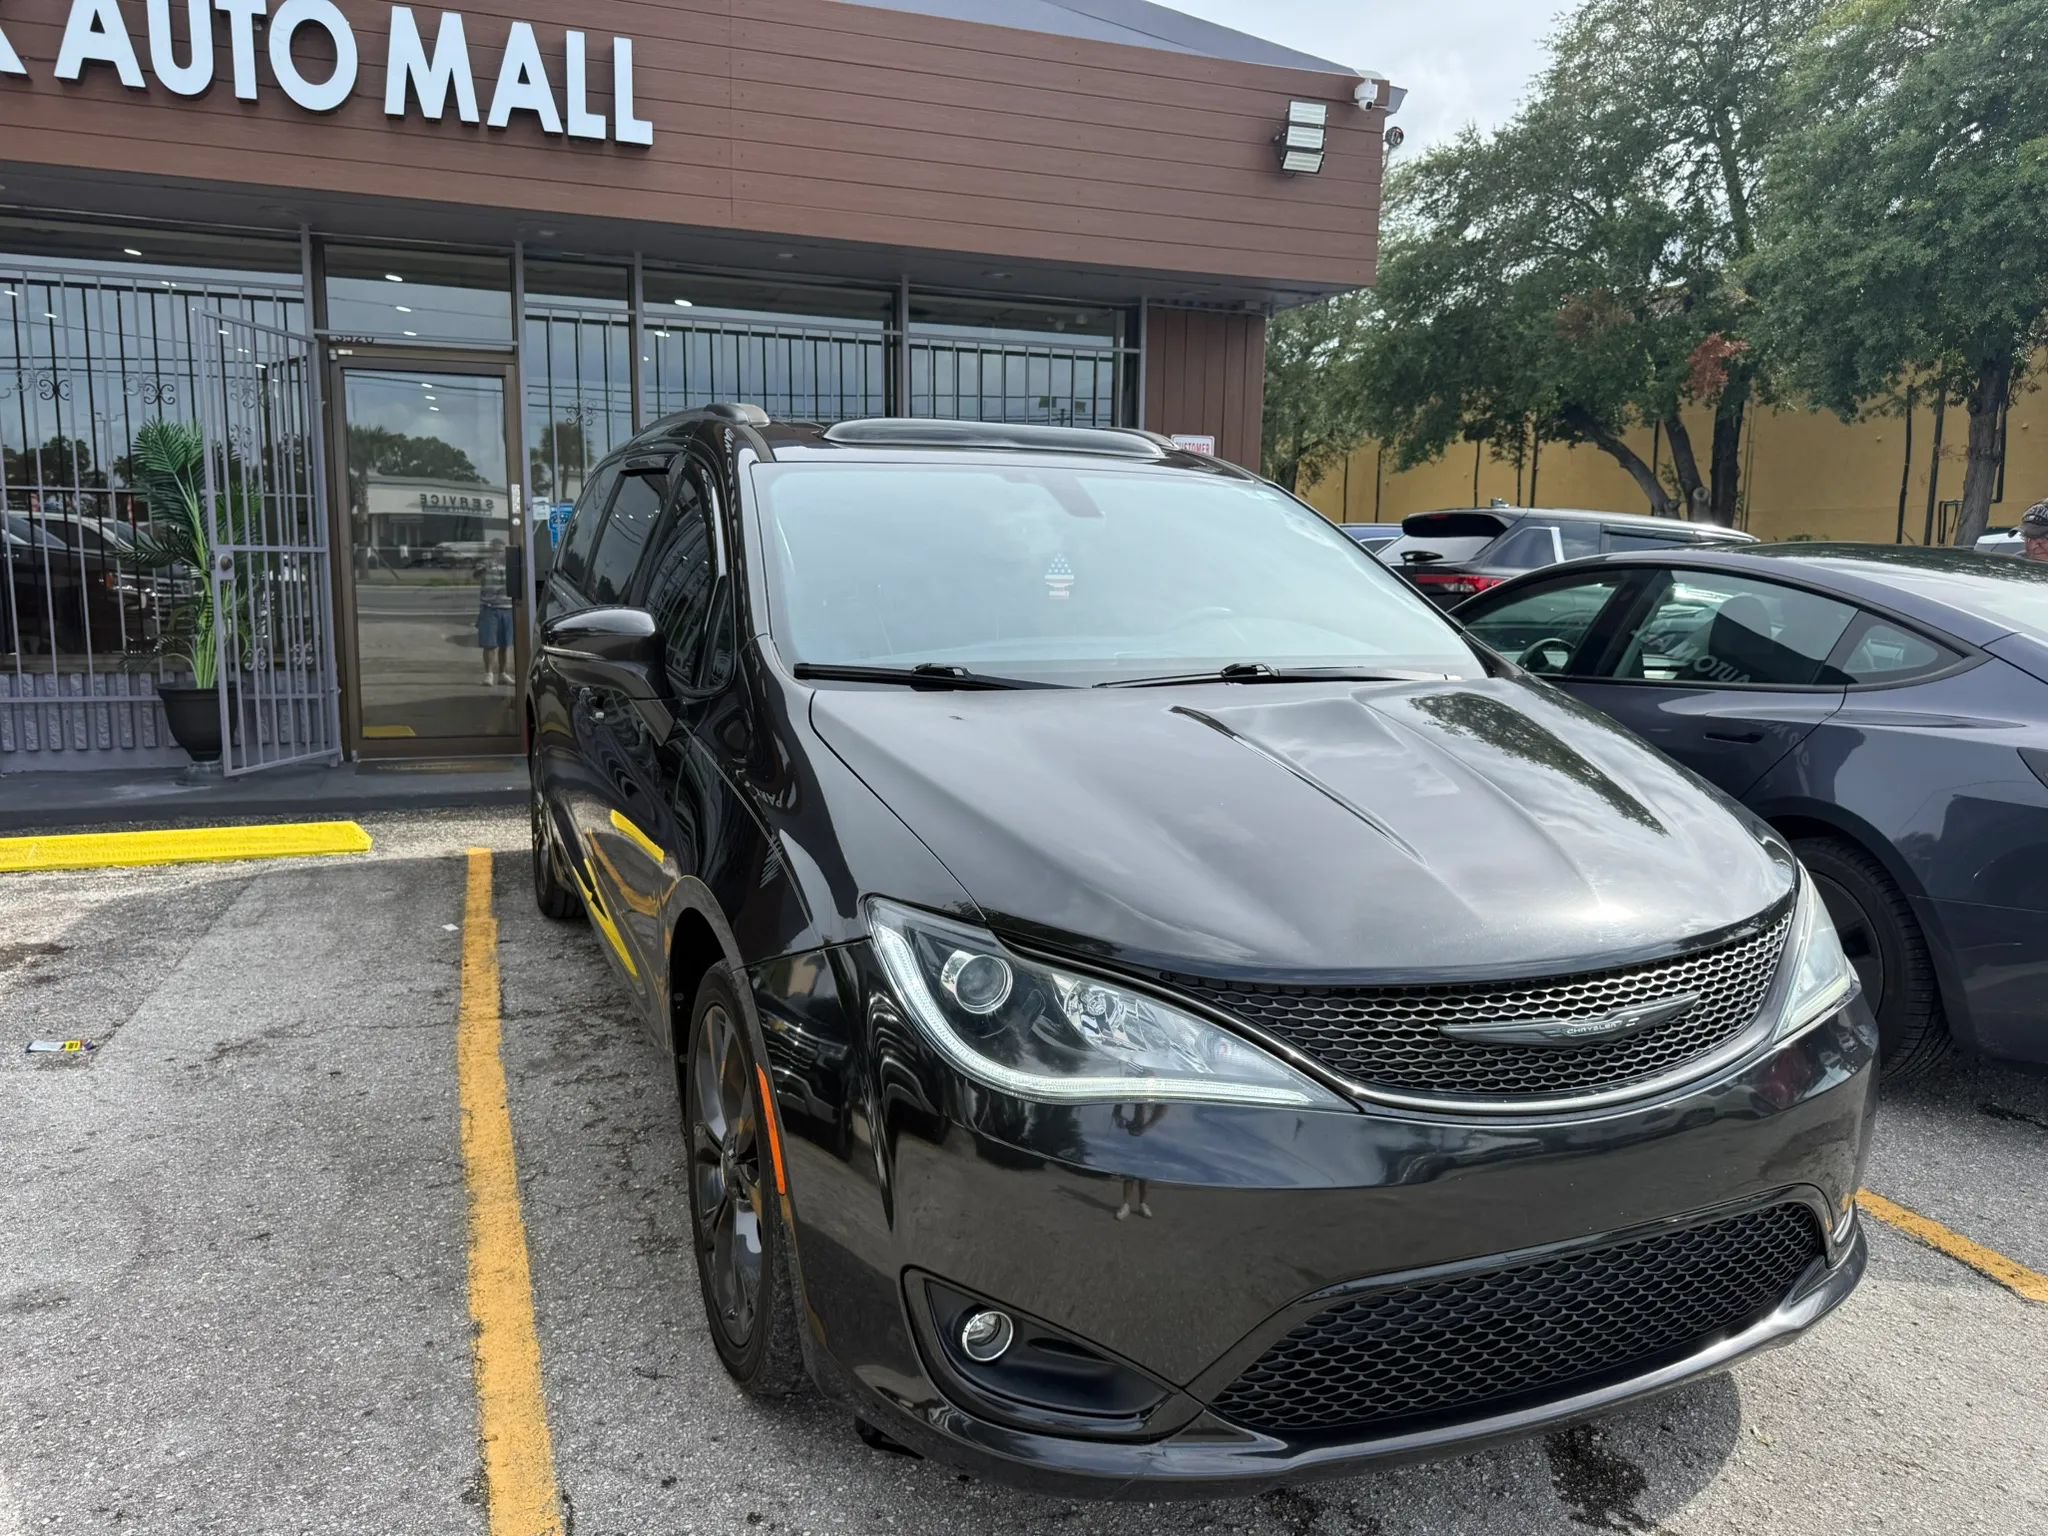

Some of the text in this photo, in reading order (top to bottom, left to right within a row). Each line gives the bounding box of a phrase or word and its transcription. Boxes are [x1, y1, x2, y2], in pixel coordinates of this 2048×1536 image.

[54, 0, 653, 145] AUTO MALL
[1567, 1022, 1617, 1034] CHRYSLER
